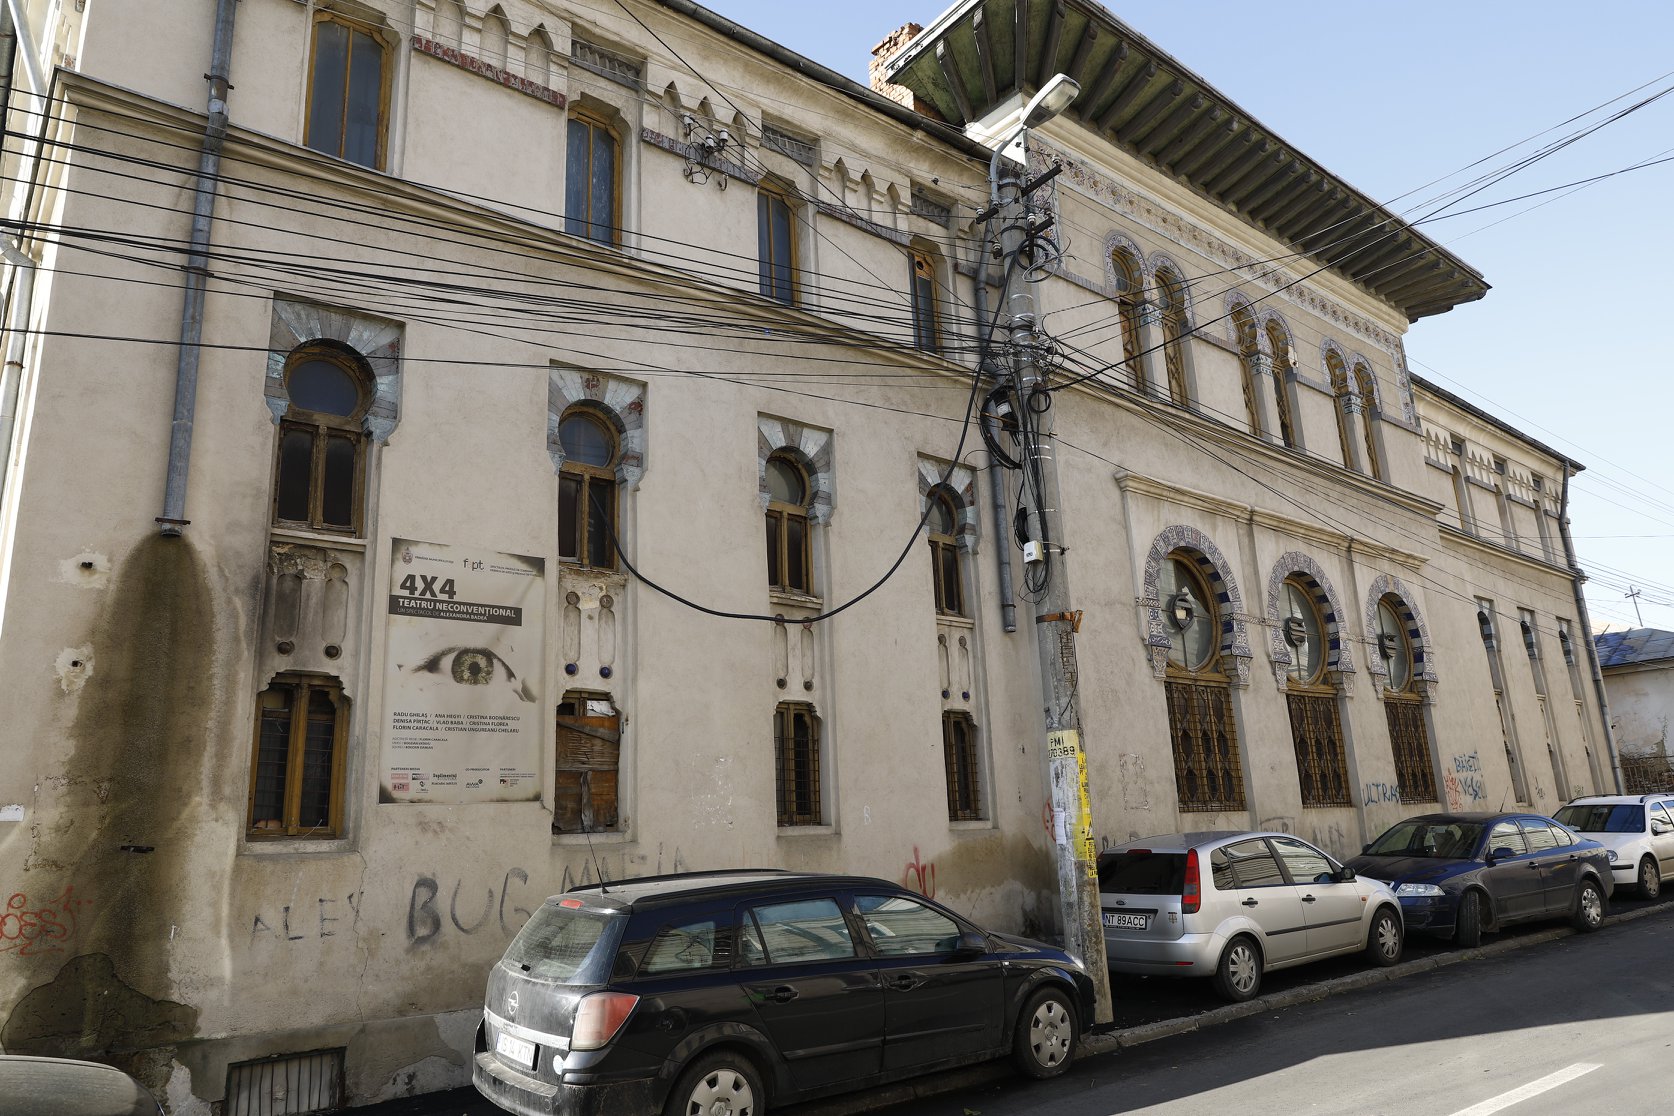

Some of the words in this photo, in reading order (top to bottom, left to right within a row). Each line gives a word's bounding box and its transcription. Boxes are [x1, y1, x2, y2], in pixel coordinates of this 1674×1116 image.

[400, 574, 456, 599] 4X4
[398, 599, 434, 609] TEATRU
[1105, 914, 1115, 925] NT
